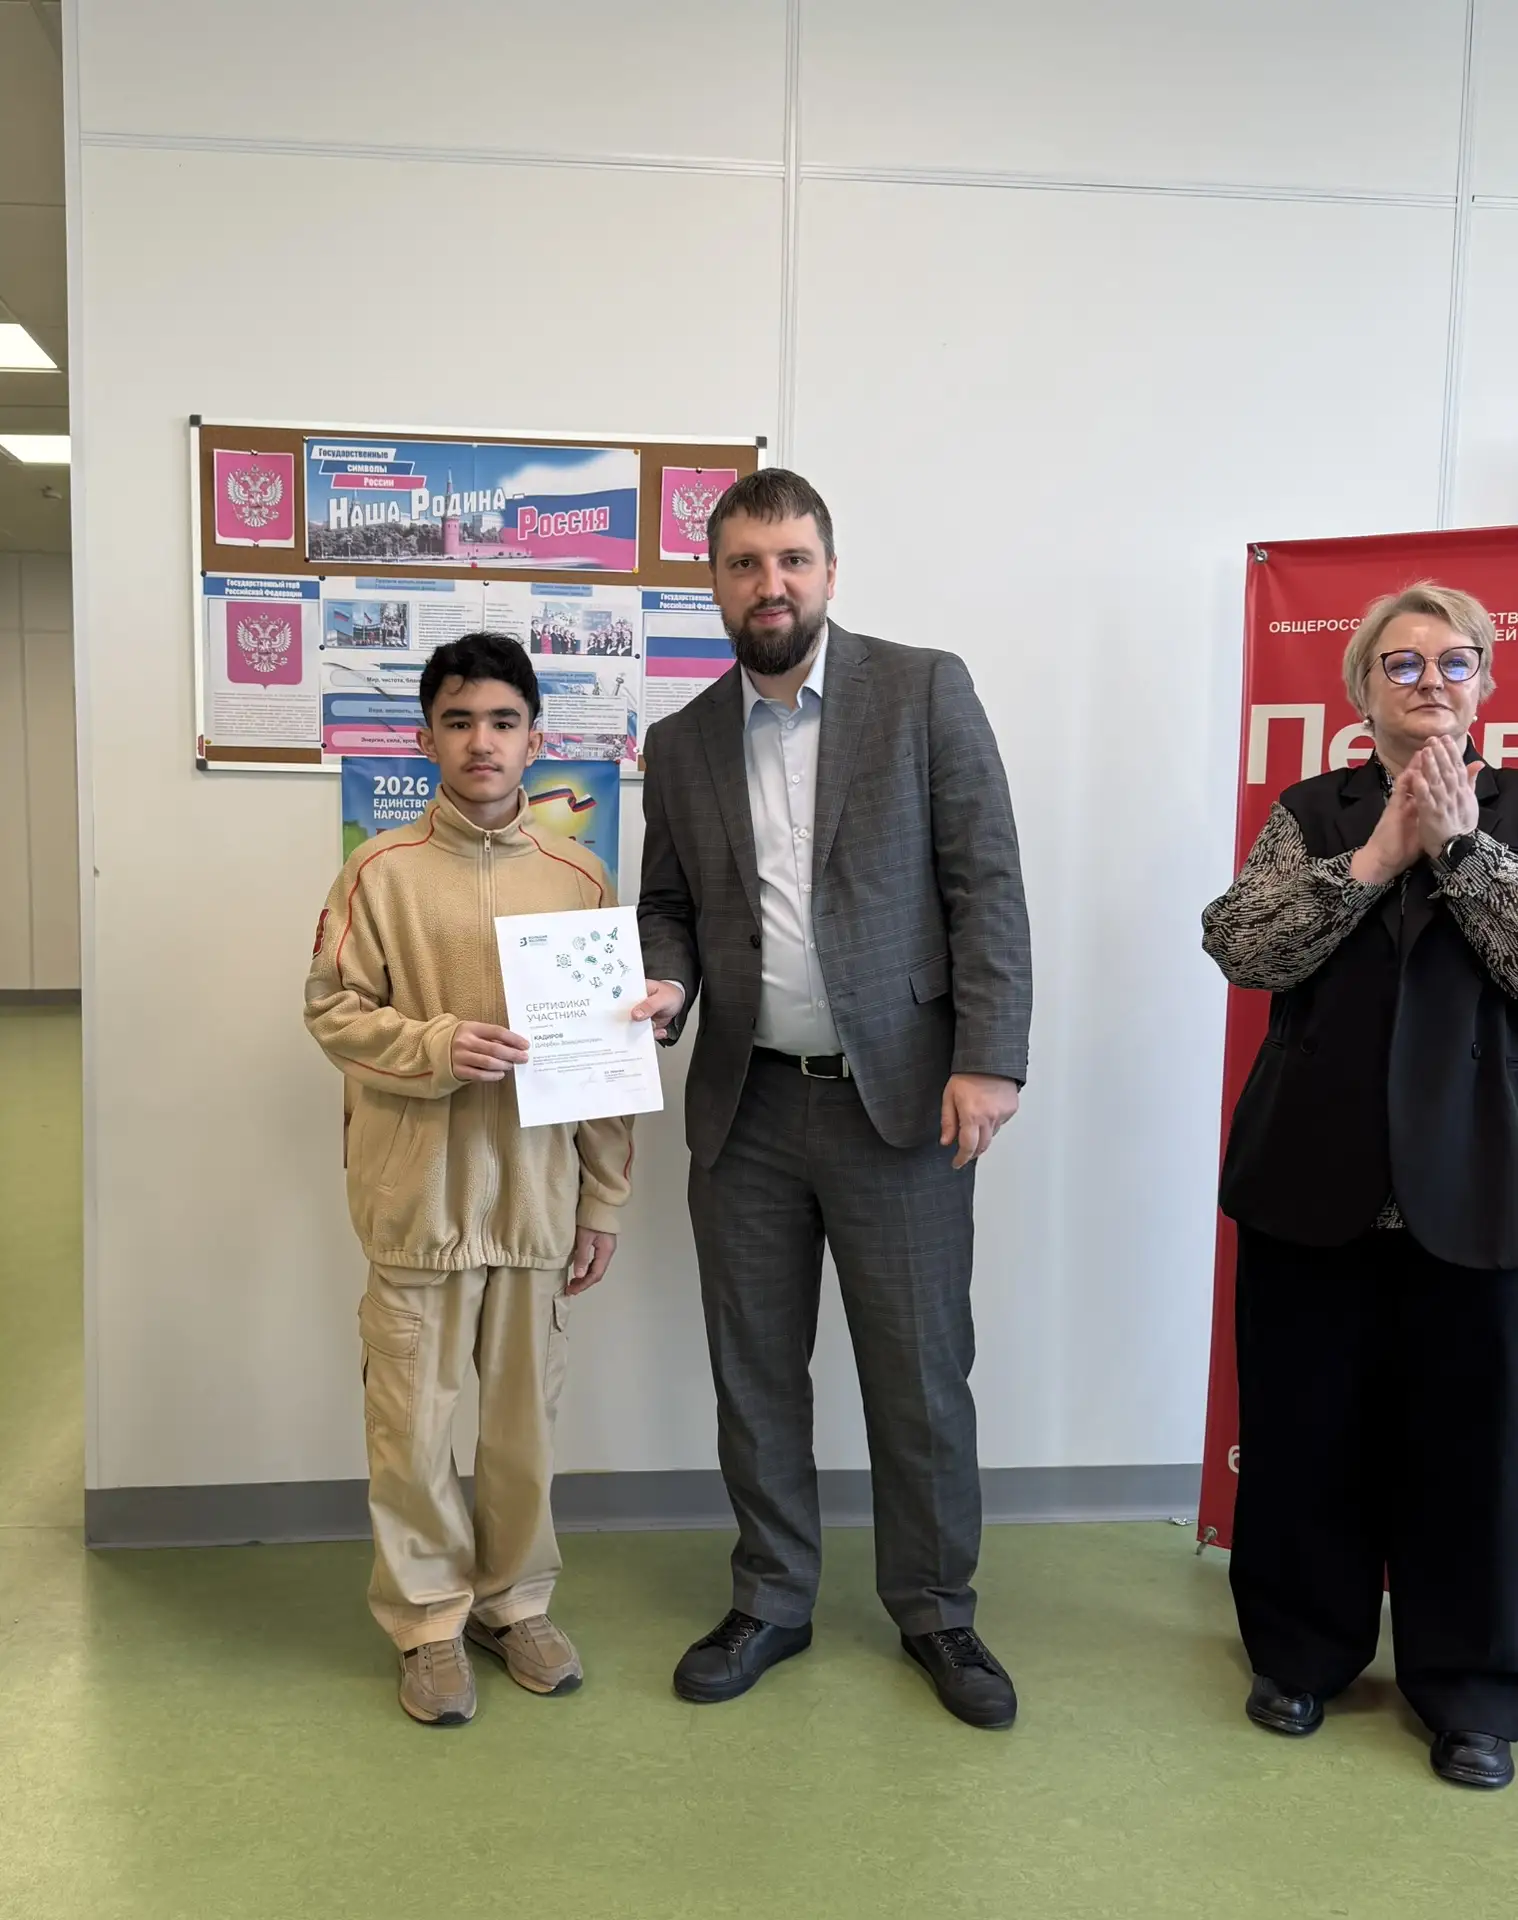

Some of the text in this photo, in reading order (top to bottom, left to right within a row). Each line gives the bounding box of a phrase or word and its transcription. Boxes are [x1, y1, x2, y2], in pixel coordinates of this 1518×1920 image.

[1269, 618, 1365, 634] ОБЩЕРОСС
[1494, 625, 1517, 642] ЕЙ
[373, 775, 430, 796] 2026
[526, 998, 591, 1013] СЕРТИФИКАТ
[526, 1009, 588, 1023] УЧАСТНИКА
